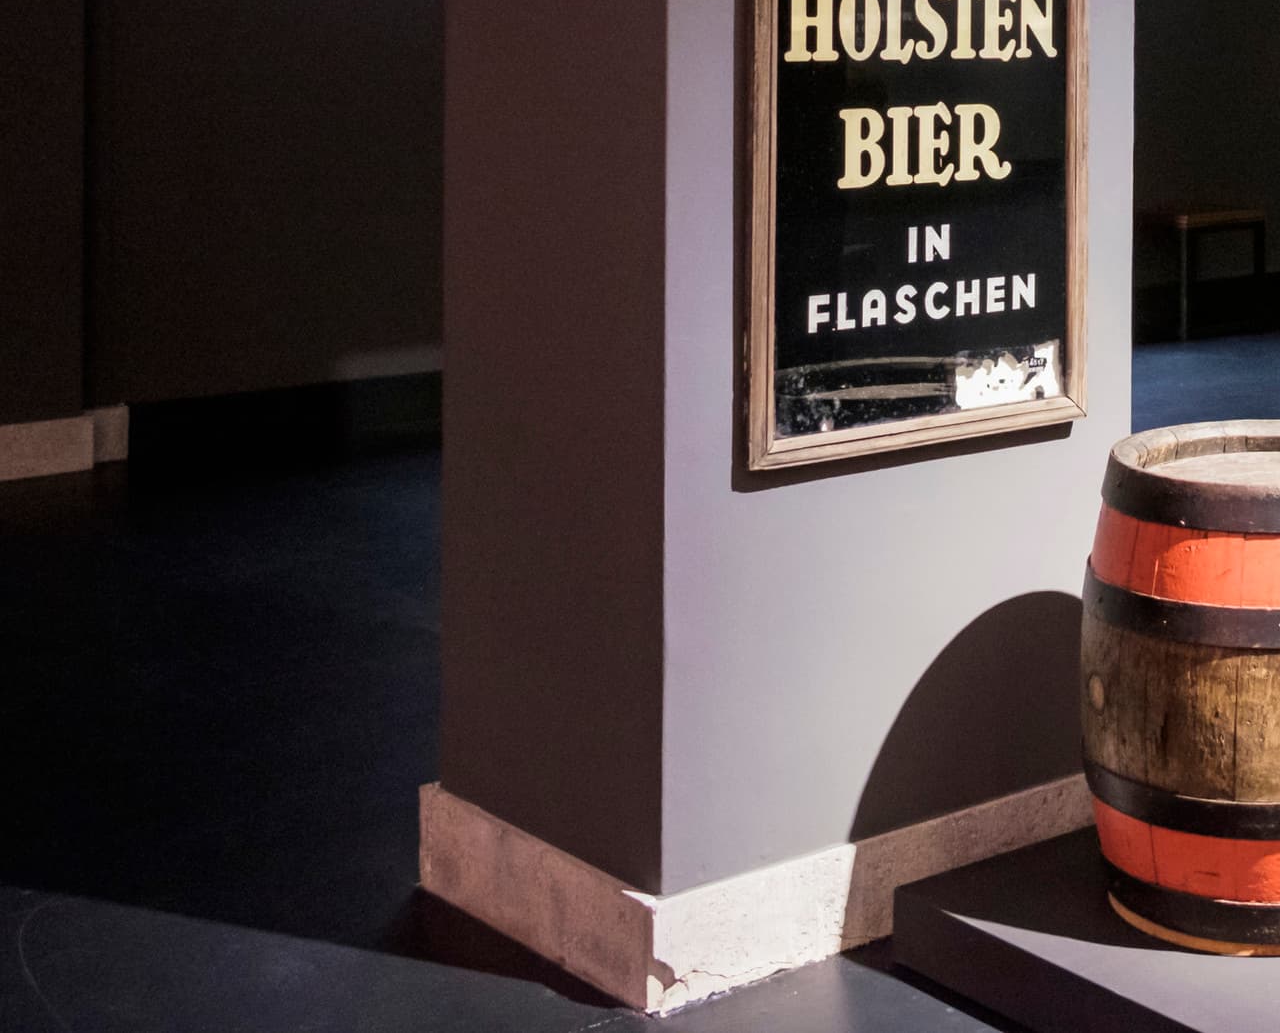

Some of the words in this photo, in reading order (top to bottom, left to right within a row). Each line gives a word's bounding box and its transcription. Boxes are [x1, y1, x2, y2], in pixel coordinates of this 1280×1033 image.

[837, 101, 1012, 189] BIER
[907, 223, 951, 264] IN
[807, 273, 1036, 334] FLASCHEN
